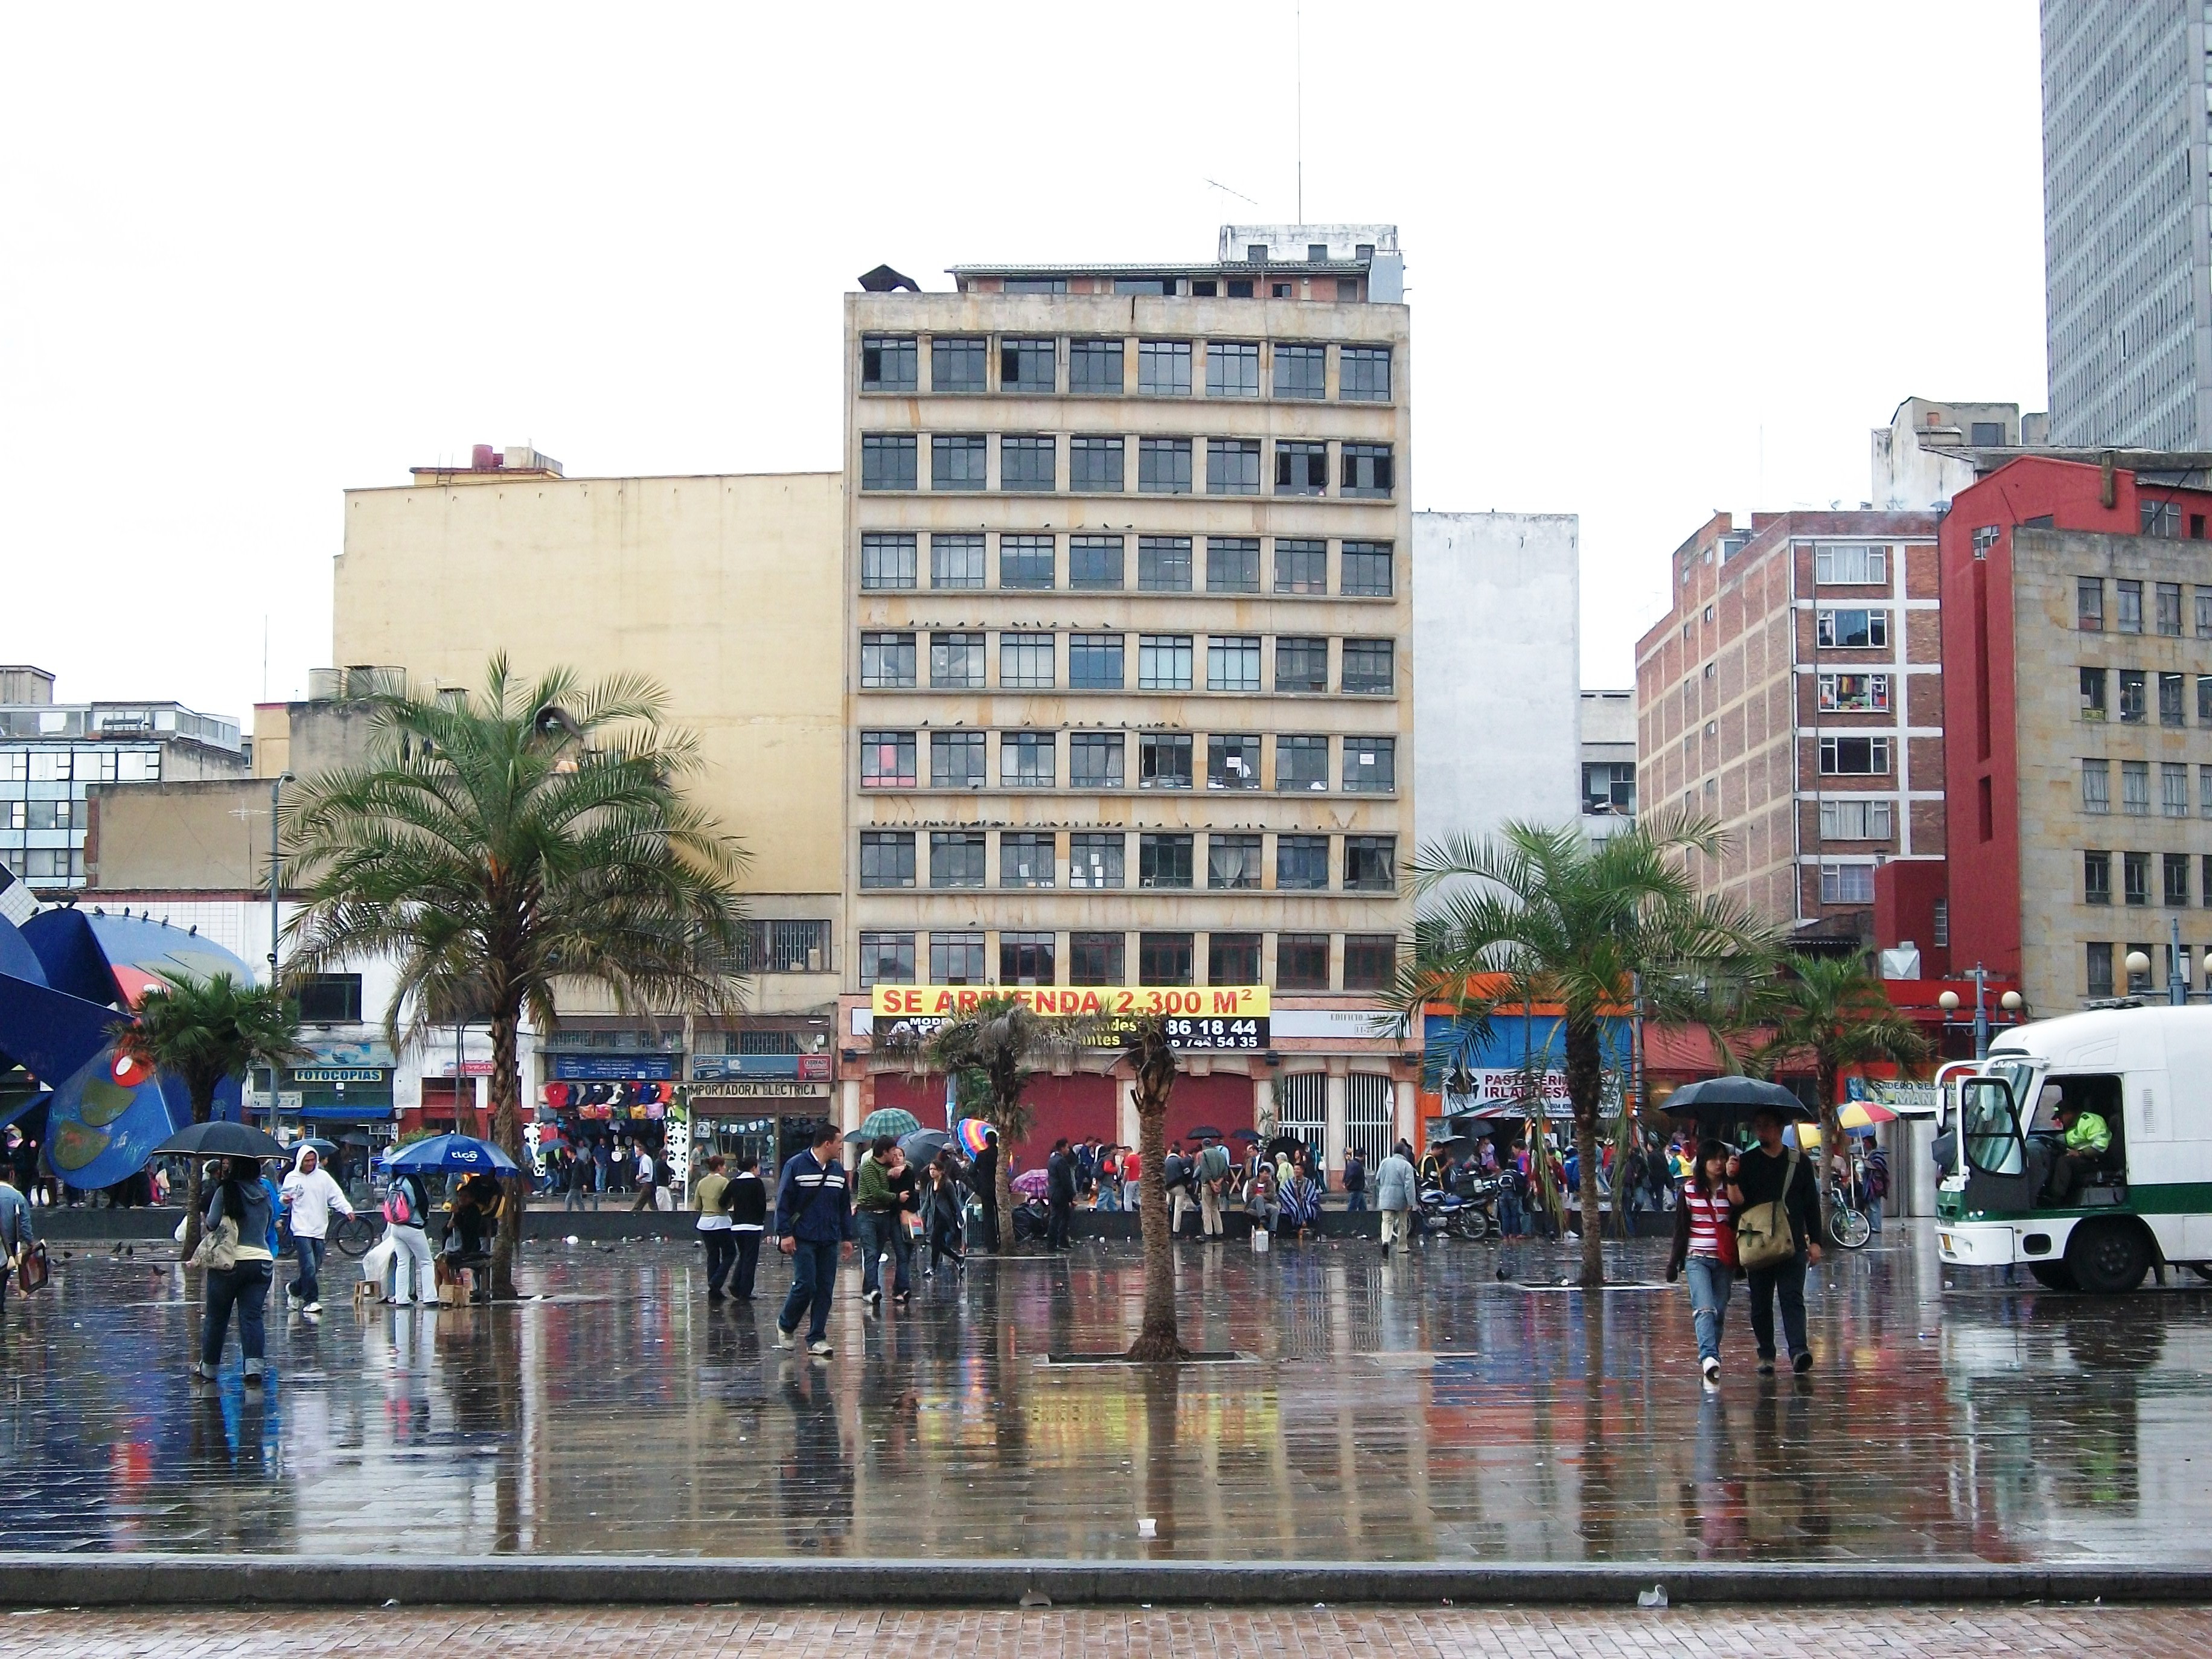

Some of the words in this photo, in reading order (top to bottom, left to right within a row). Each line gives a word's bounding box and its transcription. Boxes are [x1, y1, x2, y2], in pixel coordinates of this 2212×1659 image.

[883, 989, 922, 1013] SE
[1117, 991, 1201, 1014] 2.300
[1165, 1019, 1192, 1035] 86
[1198, 1019, 1224, 1035] 18
[1230, 1019, 1257, 1035] 44
[1216, 1036, 1235, 1047] 54
[1239, 1036, 1258, 1047] 35
[297, 1070, 380, 1081] FOTOCOPIAS
[1485, 1075, 1570, 1085] PASTEERI
[688, 1084, 758, 1096] IMPORTADORA
[762, 1084, 817, 1096] ELECTRICA
